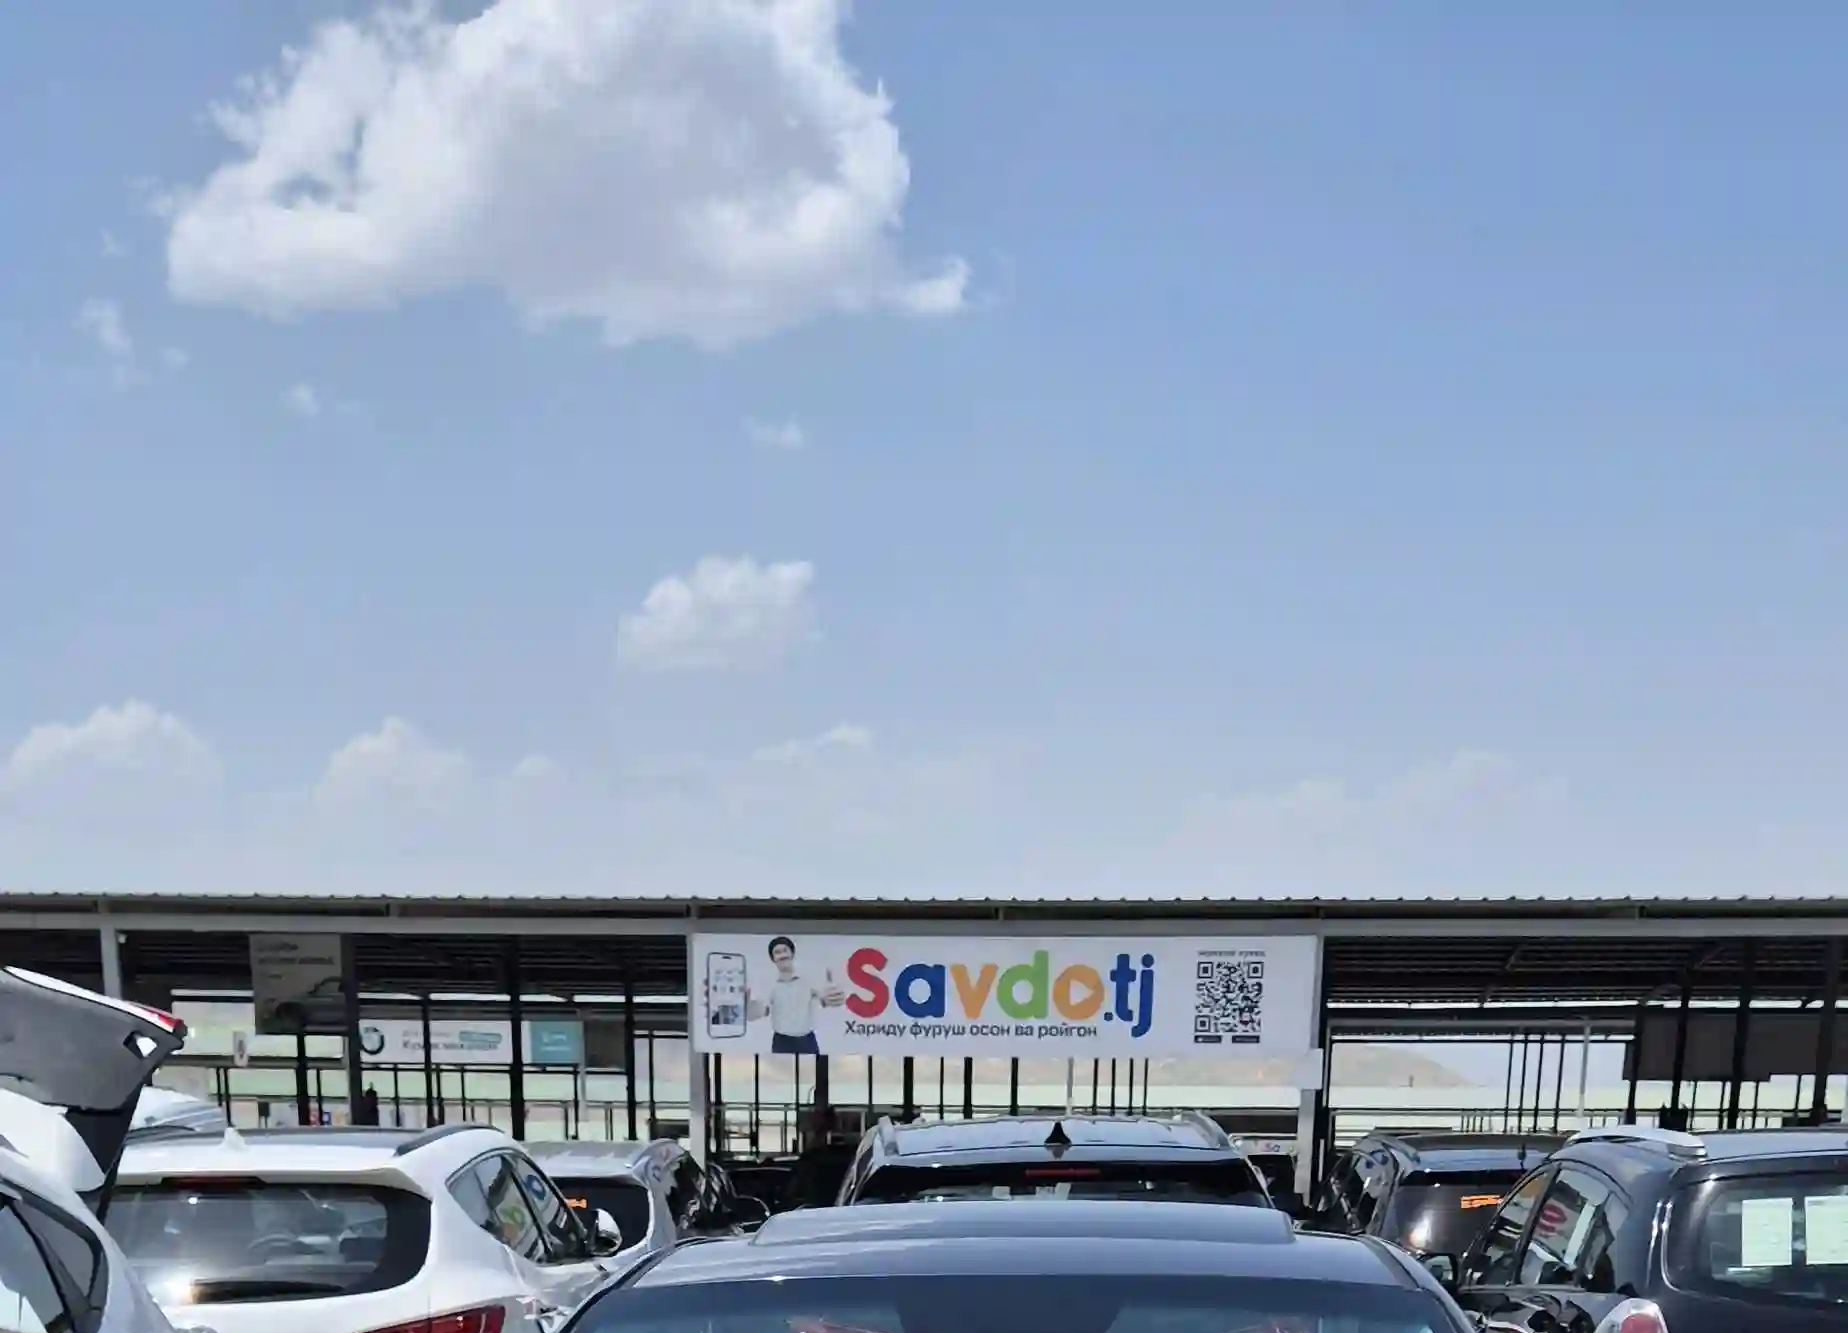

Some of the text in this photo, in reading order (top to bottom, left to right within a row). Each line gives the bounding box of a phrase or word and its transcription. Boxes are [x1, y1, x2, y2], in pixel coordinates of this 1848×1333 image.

[845, 947, 1155, 1039] Savdo.tj
[844, 1020, 1097, 1039] Хариду фуруш осон ва ройгон
